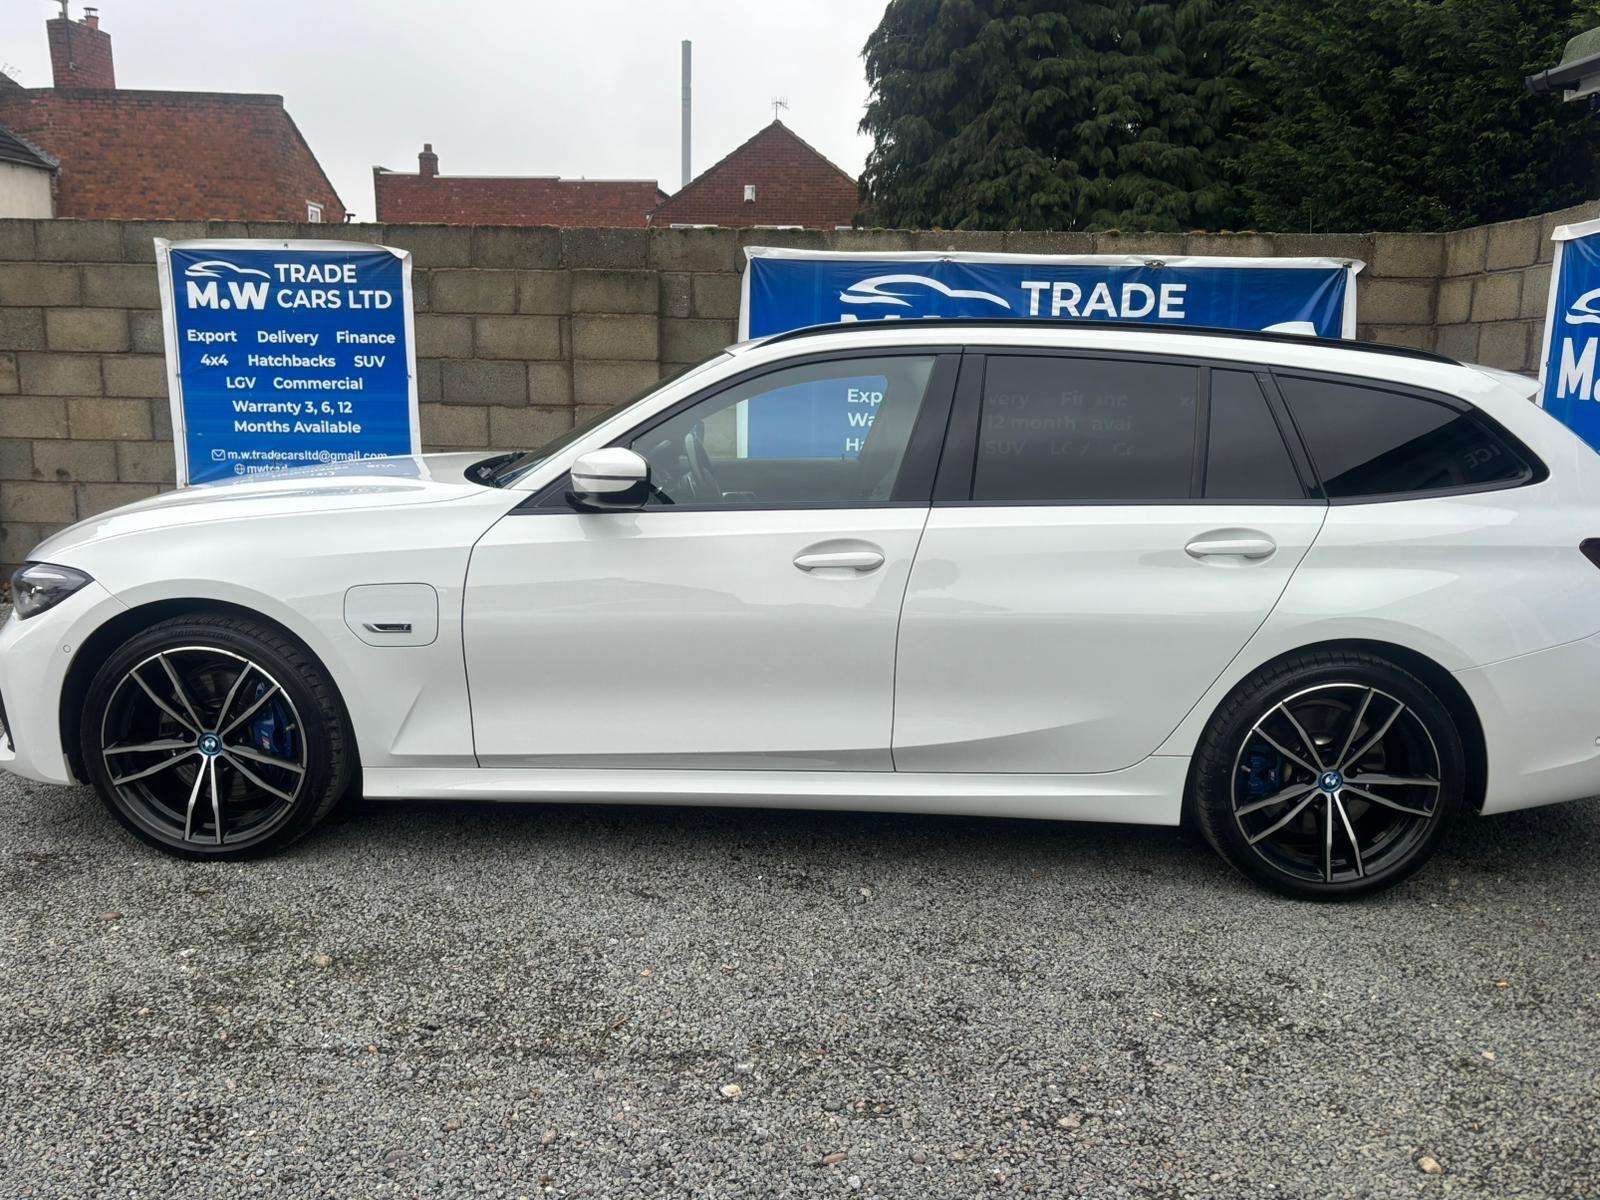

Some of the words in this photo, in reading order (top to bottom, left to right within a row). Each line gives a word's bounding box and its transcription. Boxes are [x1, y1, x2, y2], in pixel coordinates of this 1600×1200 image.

[274, 264, 357, 283] TRADE
[187, 281, 269, 309] M.W
[277, 289, 341, 308] CARS
[349, 290, 392, 308] LTD
[1021, 281, 1186, 318] TRADE
[188, 330, 237, 344] Export
[258, 330, 318, 345] Delivery
[337, 331, 395, 343] Finance
[201, 354, 228, 366] 4x4
[249, 355, 335, 367] Hatchbacks
[355, 356, 385, 367] SUV
[1557, 338, 1600, 401] M
[227, 377, 256, 388] LGV
[274, 377, 362, 389] Commercial
[233, 401, 301, 415] Warranty
[305, 402, 317, 414] 3,
[322, 402, 334, 415] 6,
[338, 402, 352, 413] 12
[235, 421, 290, 432] Months
[294, 421, 361, 433] Available
